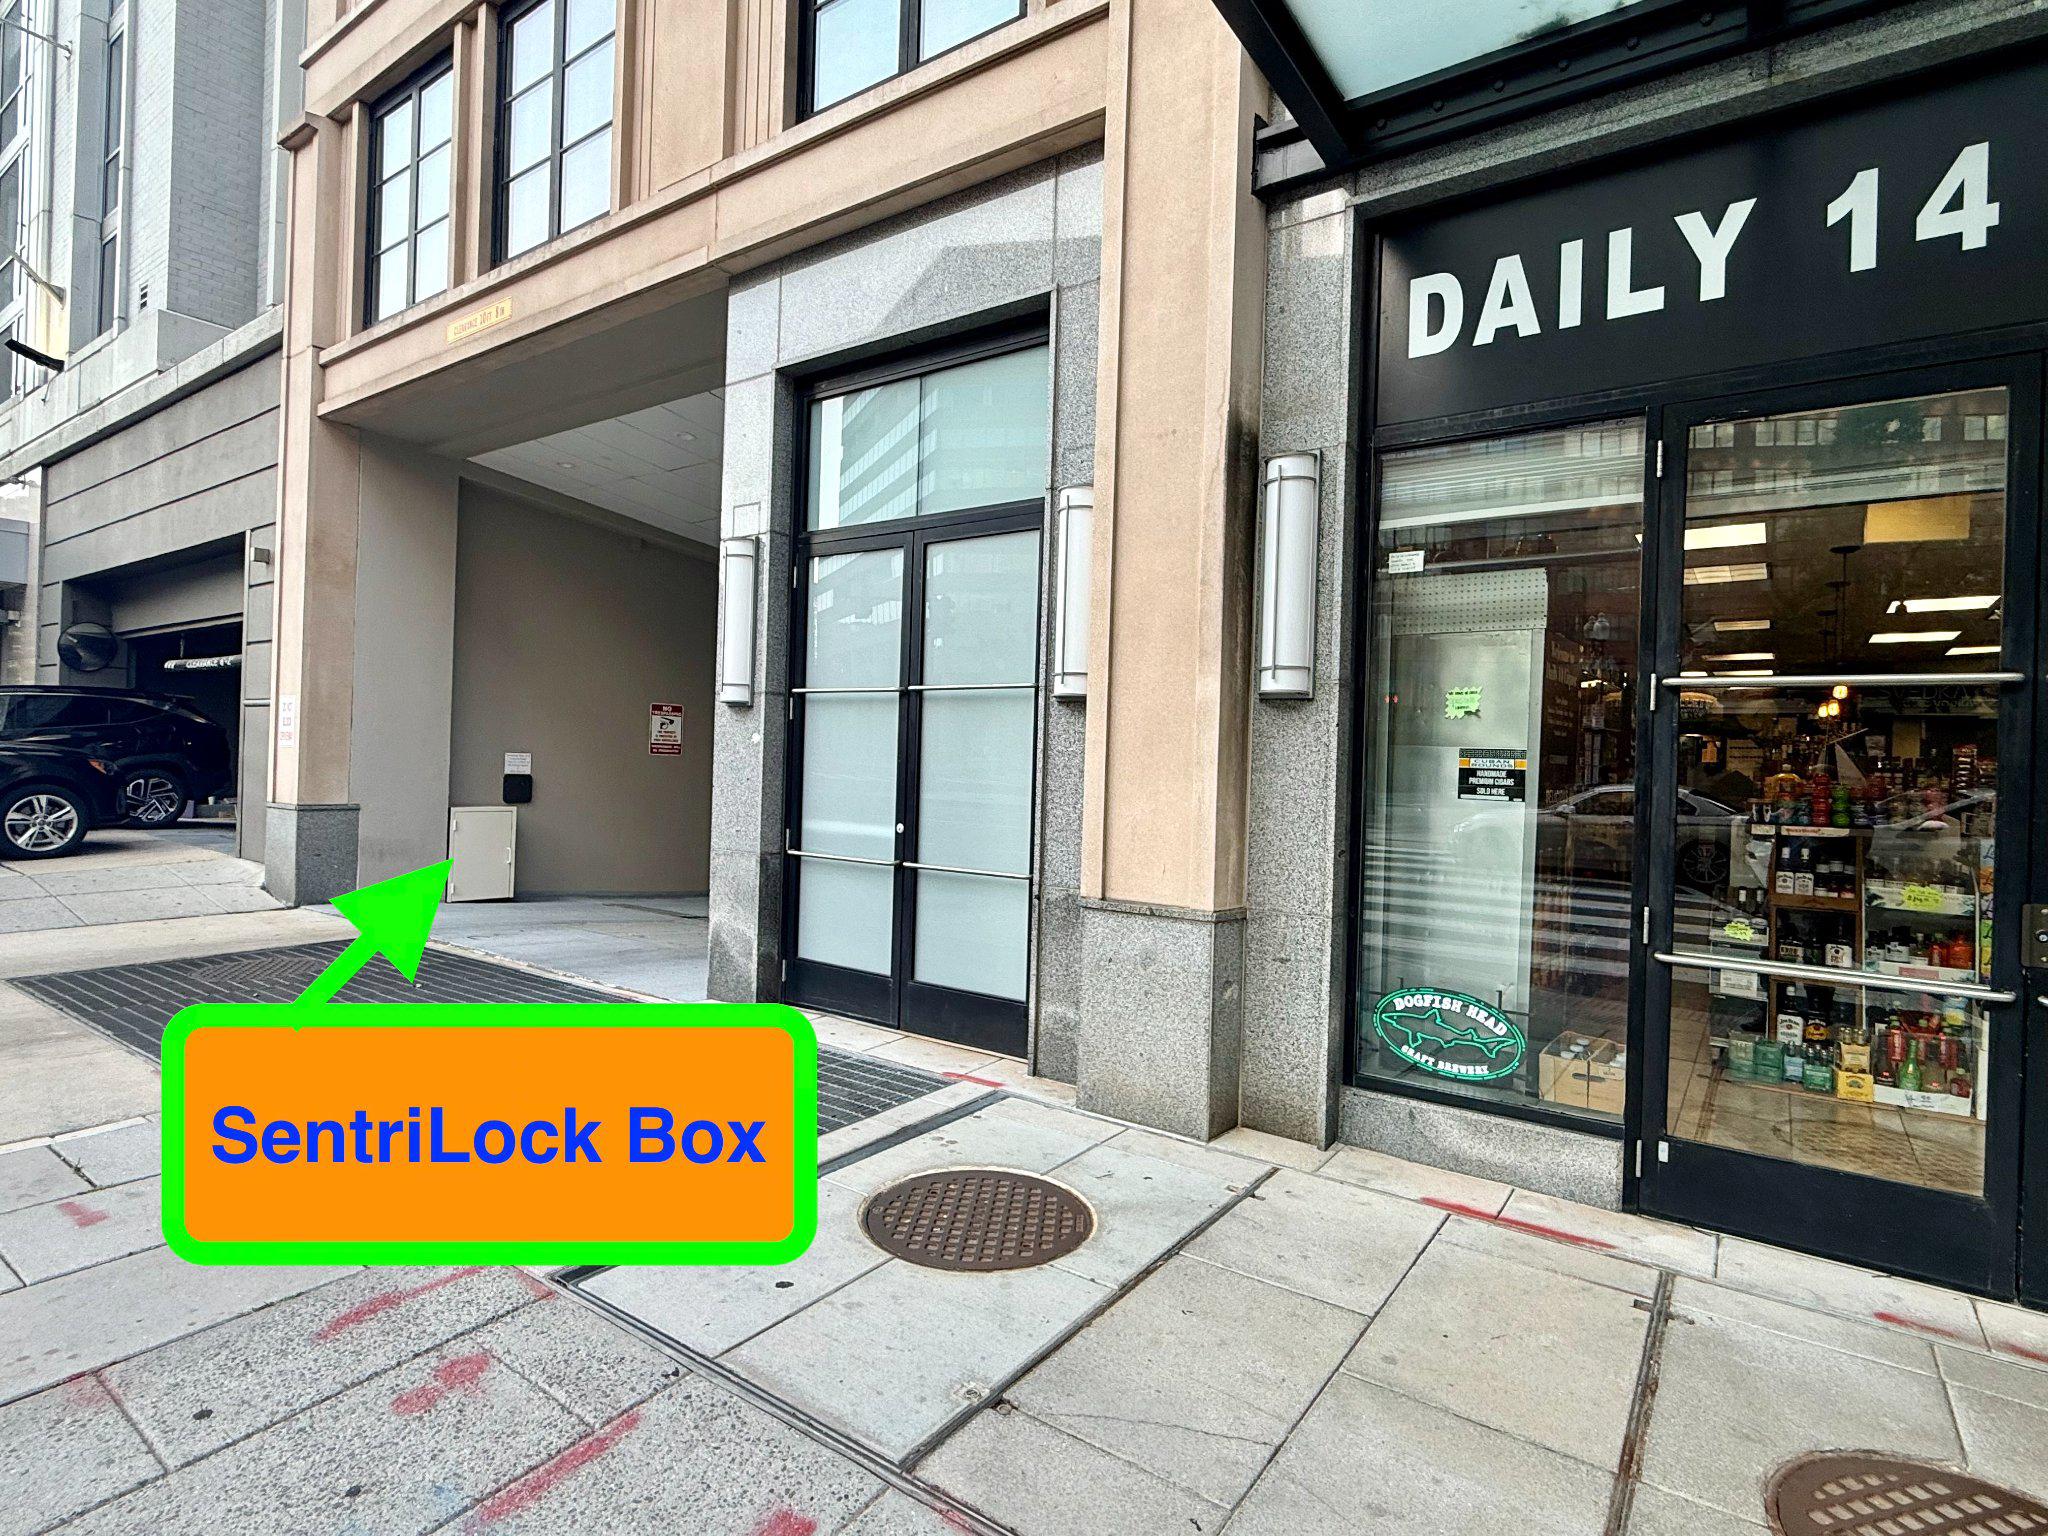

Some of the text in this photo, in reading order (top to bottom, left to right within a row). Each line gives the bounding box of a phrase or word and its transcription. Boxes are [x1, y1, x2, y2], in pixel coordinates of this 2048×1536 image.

[1408, 141, 2000, 359] DAILY 14
[1468, 777, 1515, 786] PREMIUM CIGARS
[1476, 770, 1508, 778] HANDMADE
[1476, 787, 1506, 796] SOLD HERE
[1392, 993, 1508, 1036] DOGFISH HEAD
[1400, 1044, 1490, 1075] CRAFT BREWERY
